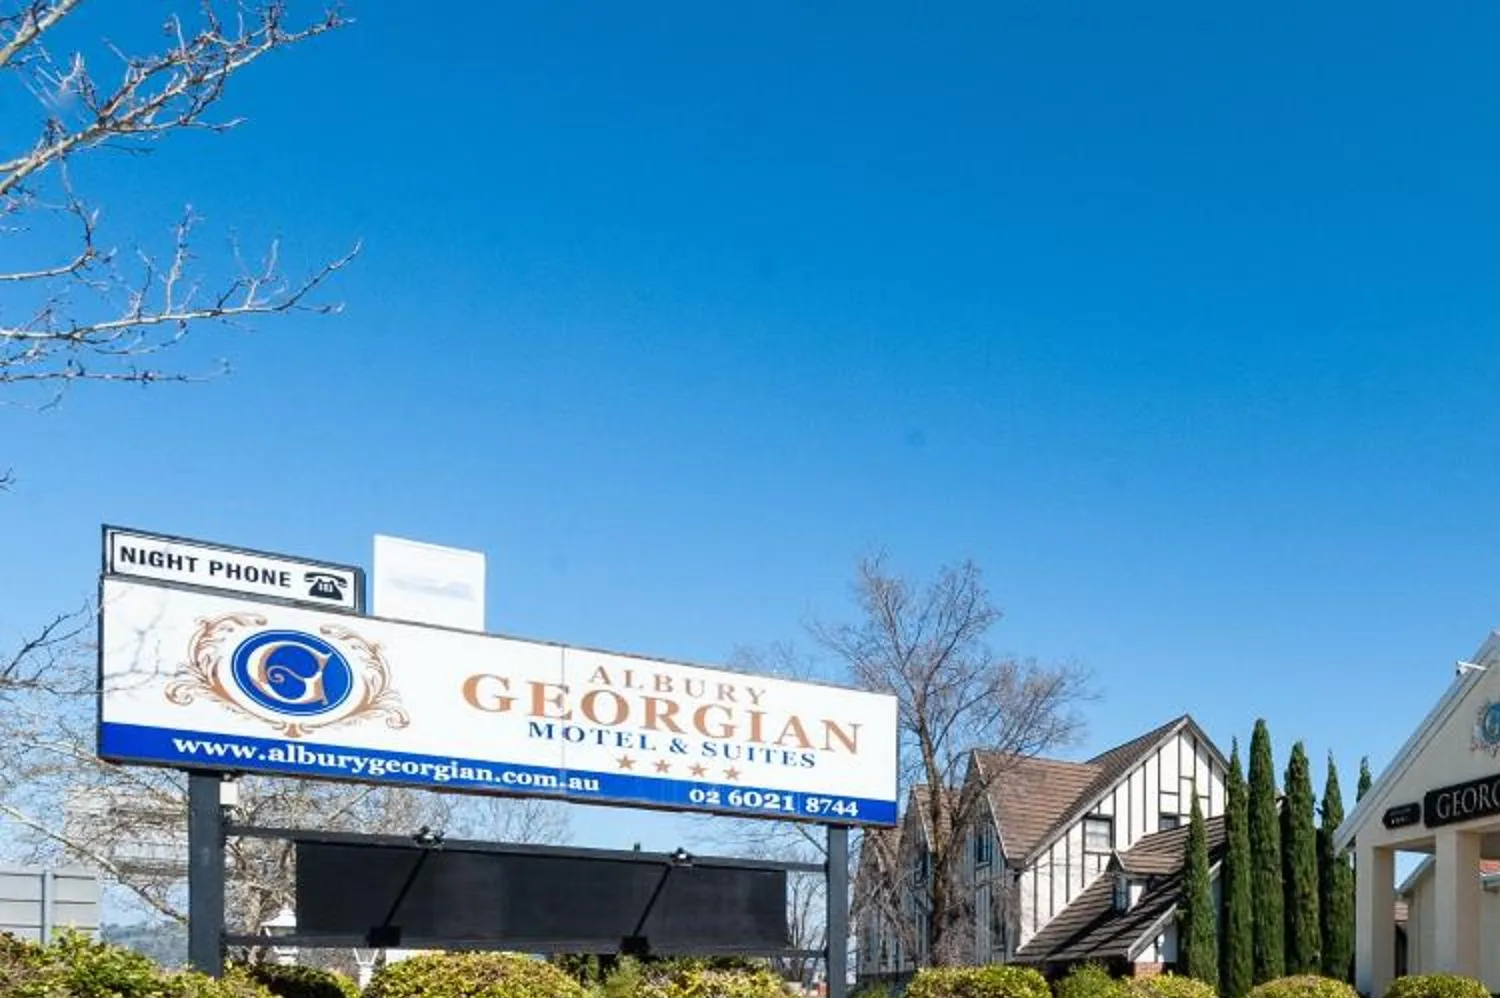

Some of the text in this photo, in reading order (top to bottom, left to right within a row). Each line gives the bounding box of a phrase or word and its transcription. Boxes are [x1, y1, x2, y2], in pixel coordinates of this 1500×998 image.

[119, 545, 292, 588] NIGHT PHONE
[586, 665, 767, 706] ALBURY
[461, 673, 864, 755] GEORGIAN
[172, 737, 601, 792] www.alburygeorgian.com.au
[528, 721, 817, 769] MOTEL & SUITES
[689, 788, 860, 818] 02 6021 8744
